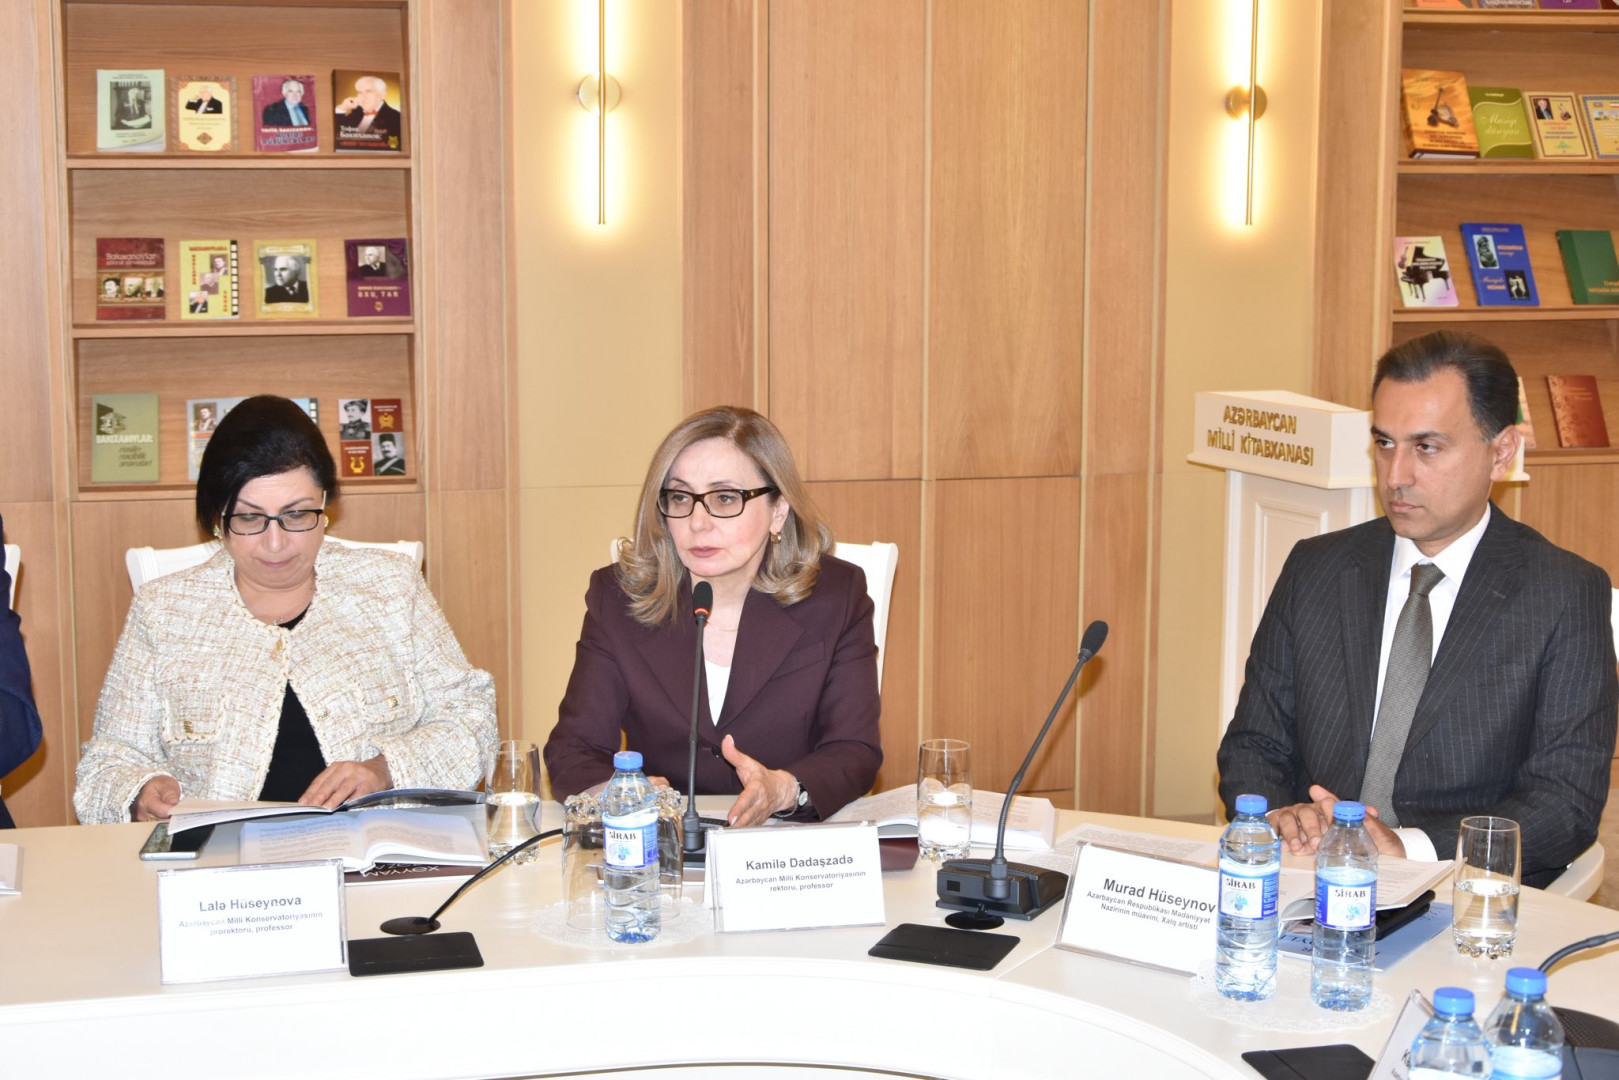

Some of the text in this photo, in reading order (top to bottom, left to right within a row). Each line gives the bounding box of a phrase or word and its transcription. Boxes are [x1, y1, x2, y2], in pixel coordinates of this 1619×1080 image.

[1223, 405, 1297, 434] AZƏRBAYCAN
[1207, 427, 1314, 466] MİLLİ KİTABXANASI
[746, 854, 853, 871] Kamilə Dadaşzadə
[779, 874, 794, 882] Milli
[795, 870, 866, 881] Konservatoriyasının
[1225, 878, 1256, 890] SİRAB
[770, 882, 834, 892] rektoru, professor
[1103, 878, 1216, 913] Murad Hüseynov
[199, 897, 302, 912] Lalə Hüseynova
[1086, 891, 1211, 924] Azərbaycan Respublikası Mədəniyyət
[227, 916, 243, 924] Milli
[1101, 903, 1198, 930] Nazirinin müavini, Xalq artisti
[255, 924, 293, 934] professor
